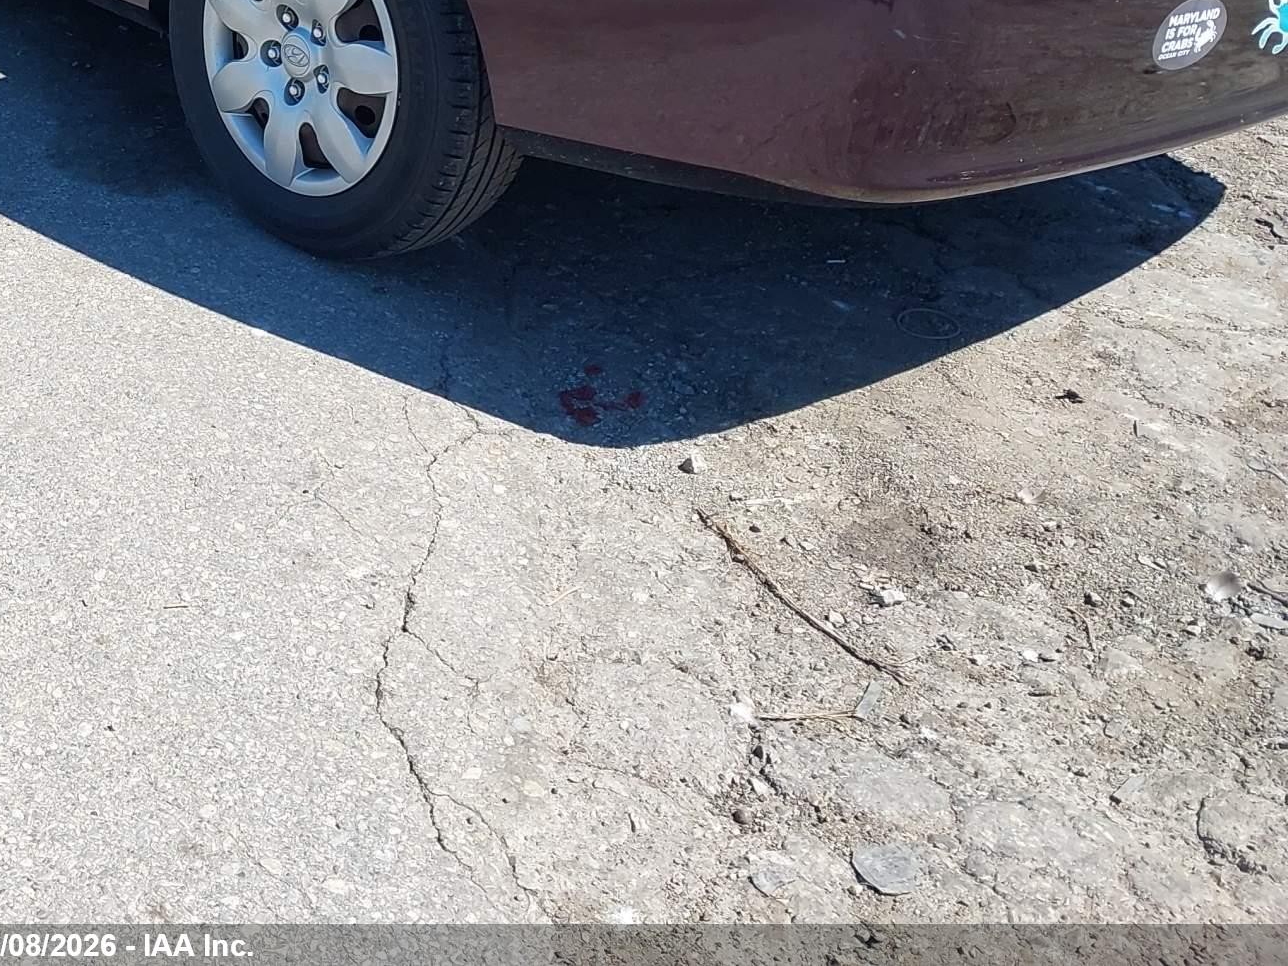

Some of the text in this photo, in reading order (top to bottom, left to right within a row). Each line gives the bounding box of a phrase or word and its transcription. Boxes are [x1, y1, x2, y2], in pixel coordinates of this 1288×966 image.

[1169, 8, 1220, 26] MARYLAND
[1165, 24, 1197, 40] IS FOR
[1162, 38, 1193, 52] CRABS
[1177, 49, 1189, 57] CITY
